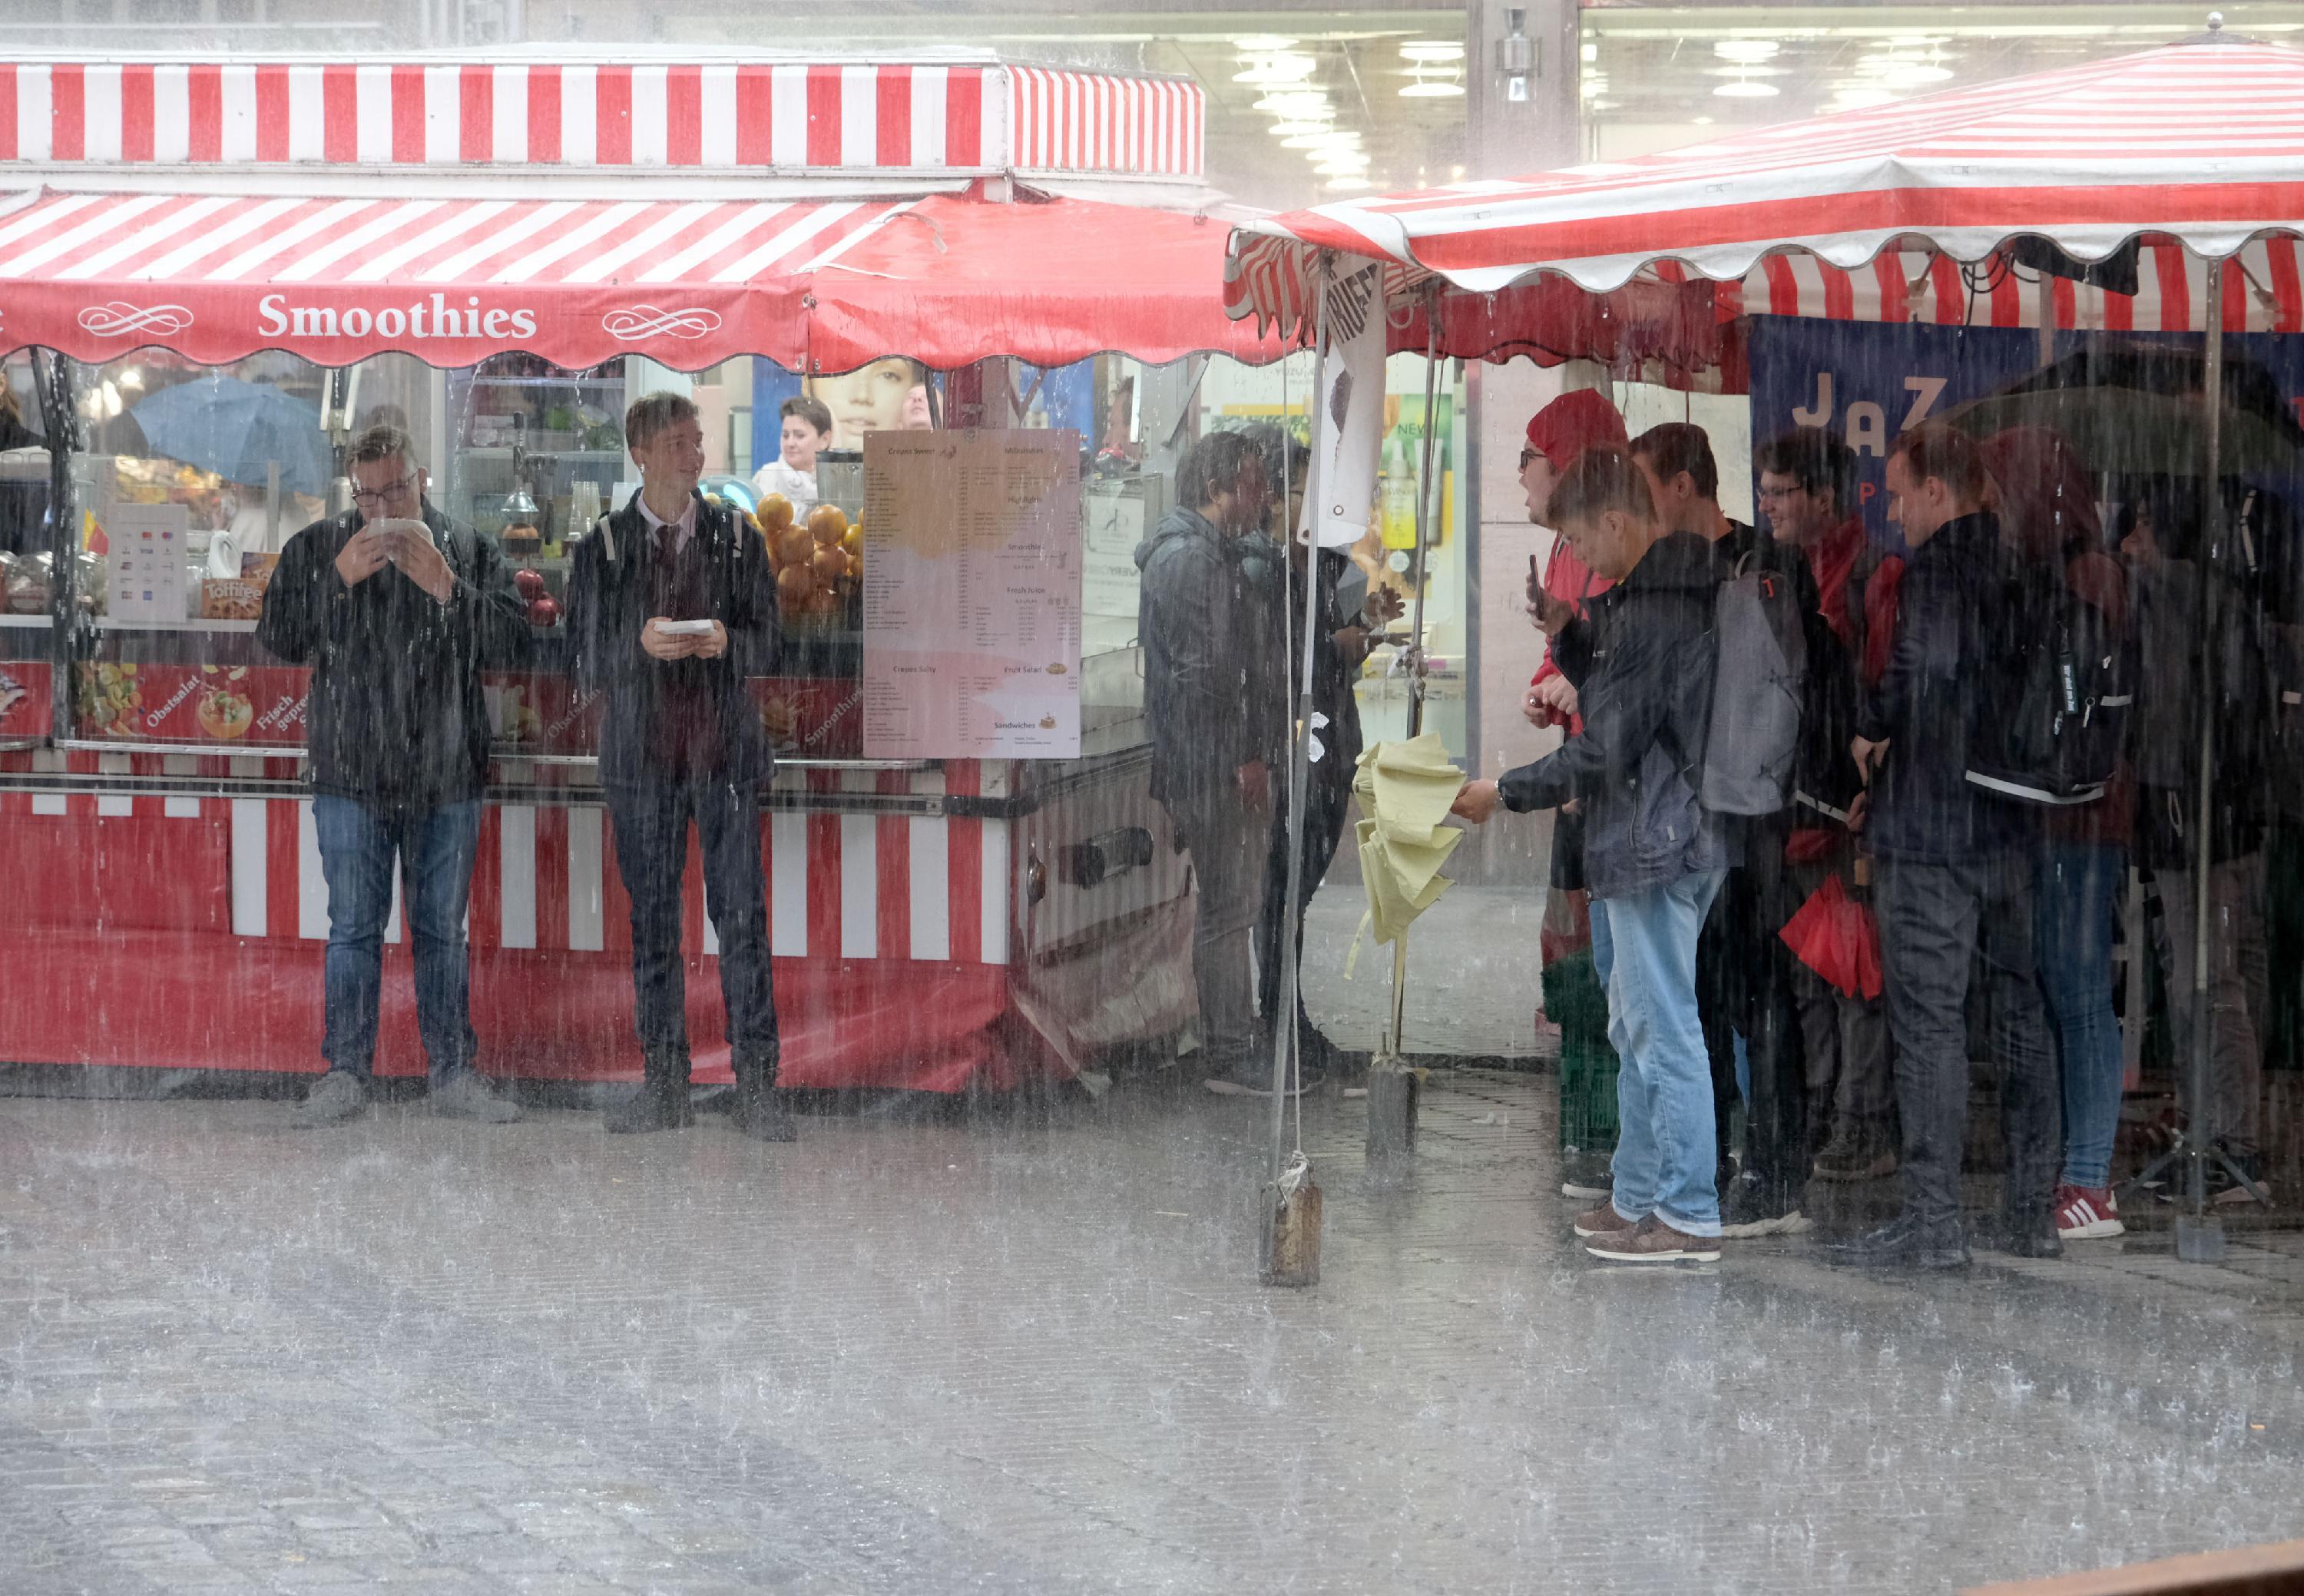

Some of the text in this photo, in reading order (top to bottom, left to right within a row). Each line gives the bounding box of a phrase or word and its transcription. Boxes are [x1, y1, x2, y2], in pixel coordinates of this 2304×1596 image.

[258, 293, 538, 339] Smoothies
[205, 581, 262, 601] Toffifee
[919, 665, 936, 674] Salty
[147, 674, 201, 727] Obstsalat
[257, 695, 294, 730] Frisch
